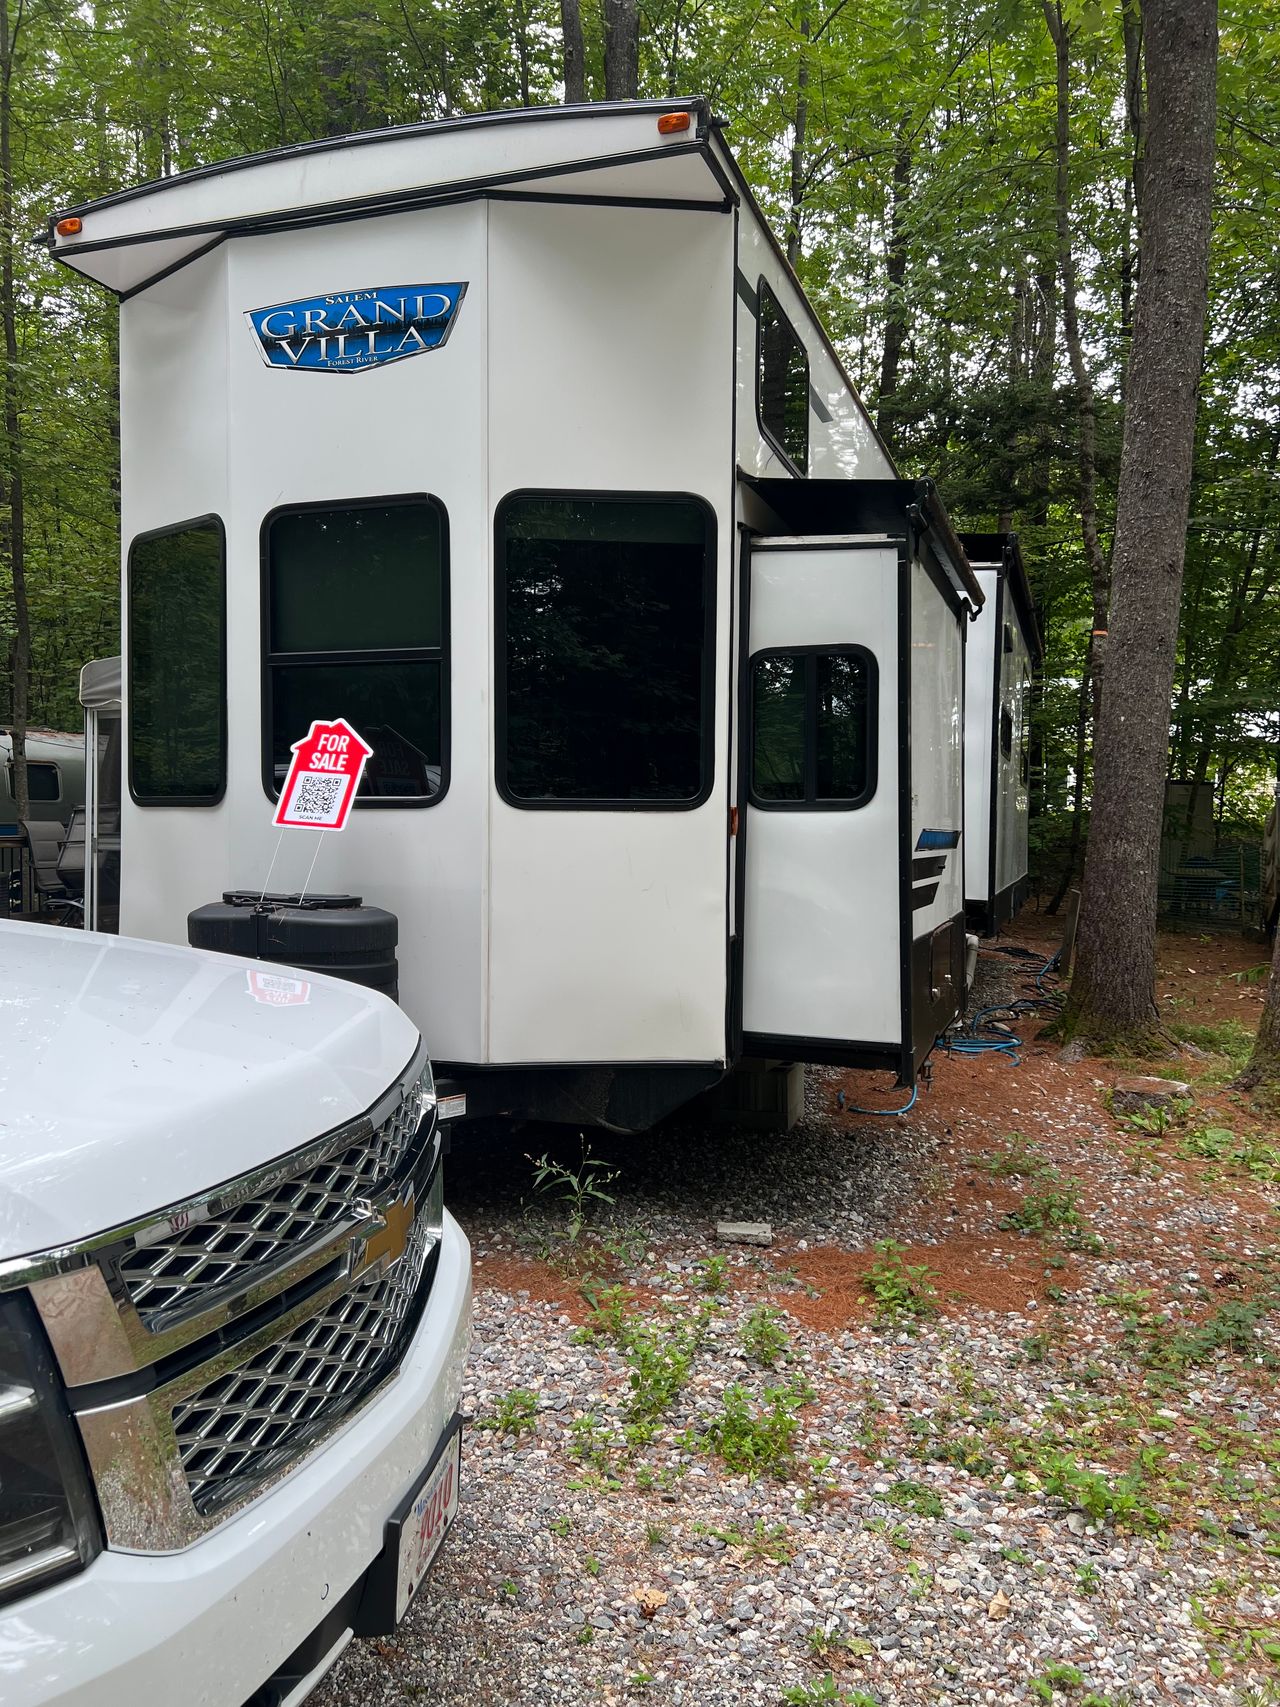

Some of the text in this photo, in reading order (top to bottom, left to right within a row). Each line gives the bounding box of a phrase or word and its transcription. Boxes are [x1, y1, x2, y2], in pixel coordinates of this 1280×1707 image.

[325, 292, 378, 305] SALEM
[262, 294, 451, 337] GRAND
[276, 326, 431, 364] VILLA
[317, 734, 350, 752] FOR
[309, 752, 349, 771] SALE
